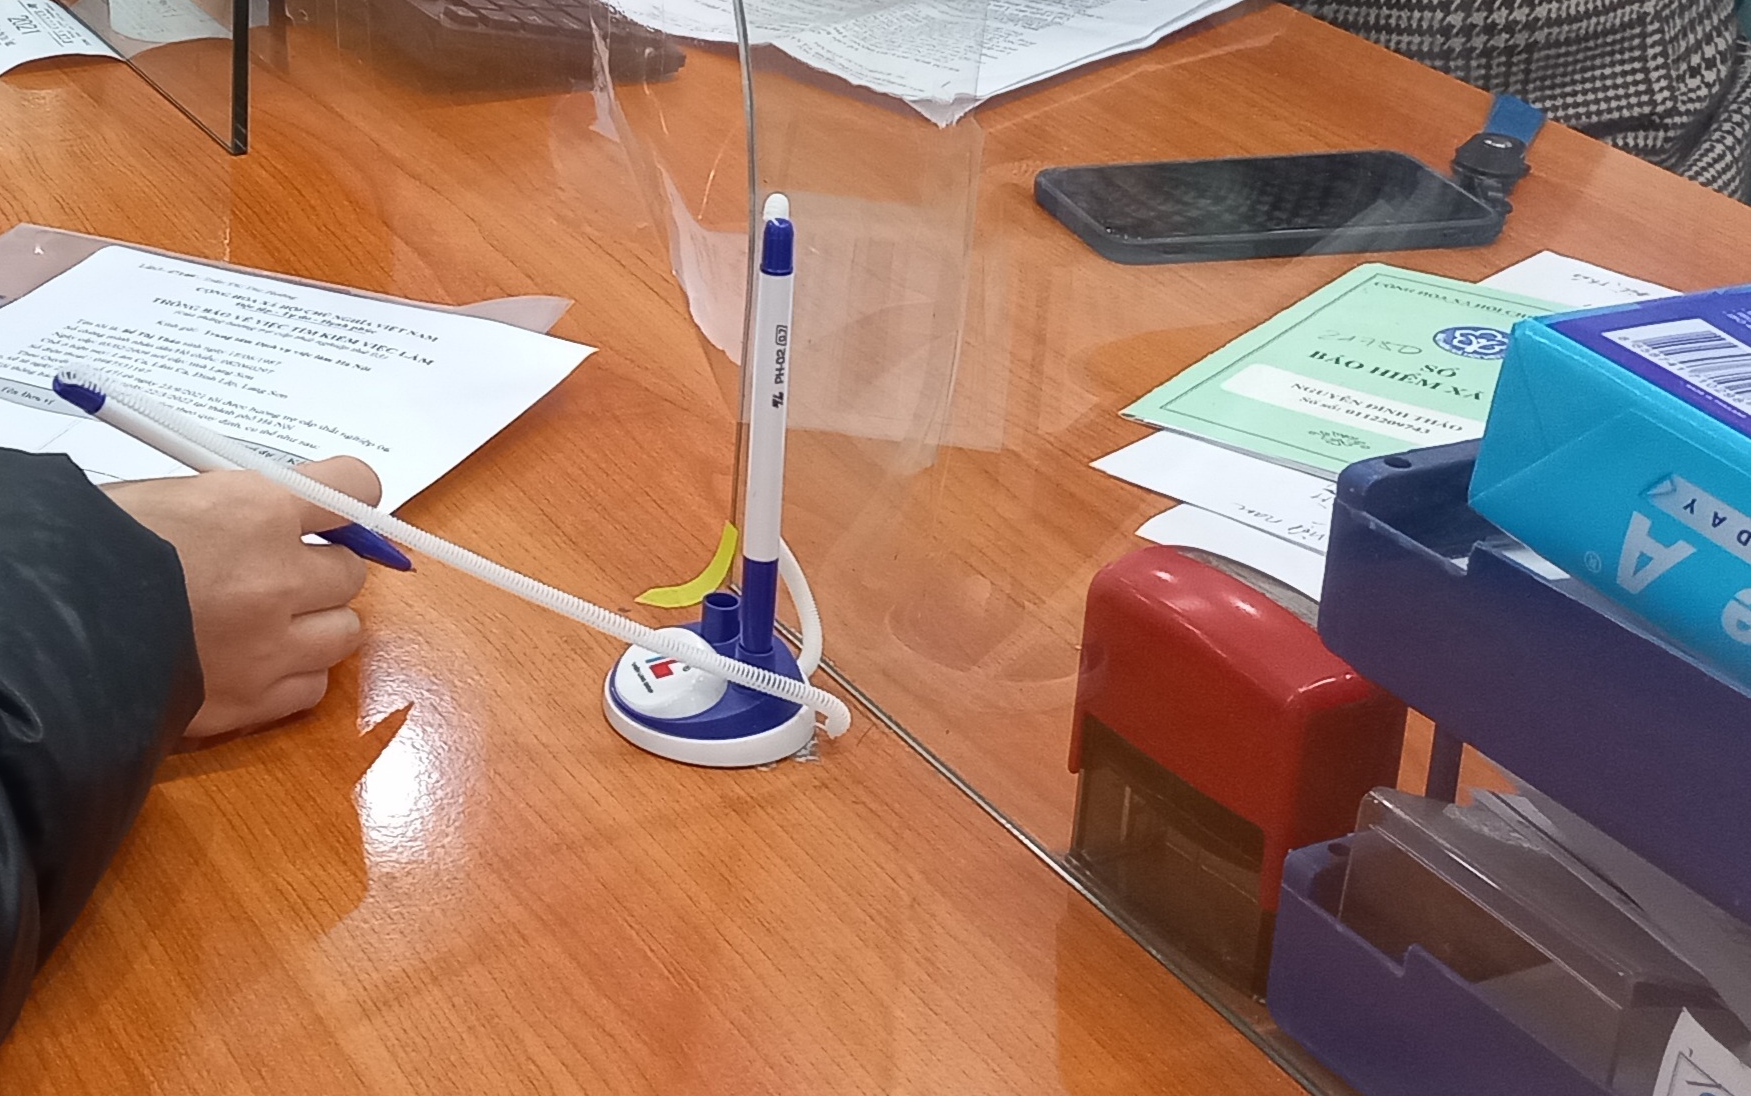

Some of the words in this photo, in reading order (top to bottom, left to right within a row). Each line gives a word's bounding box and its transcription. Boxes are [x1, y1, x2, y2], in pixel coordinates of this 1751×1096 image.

[7, 15, 41, 34] 2021
[1309, 349, 1364, 370] BẢO
[1370, 365, 1443, 391] HIỂM
[1445, 385, 1486, 402] XÃ
[1422, 363, 1459, 379] SỔ
[1292, 381, 1363, 407] NGUYỄN
